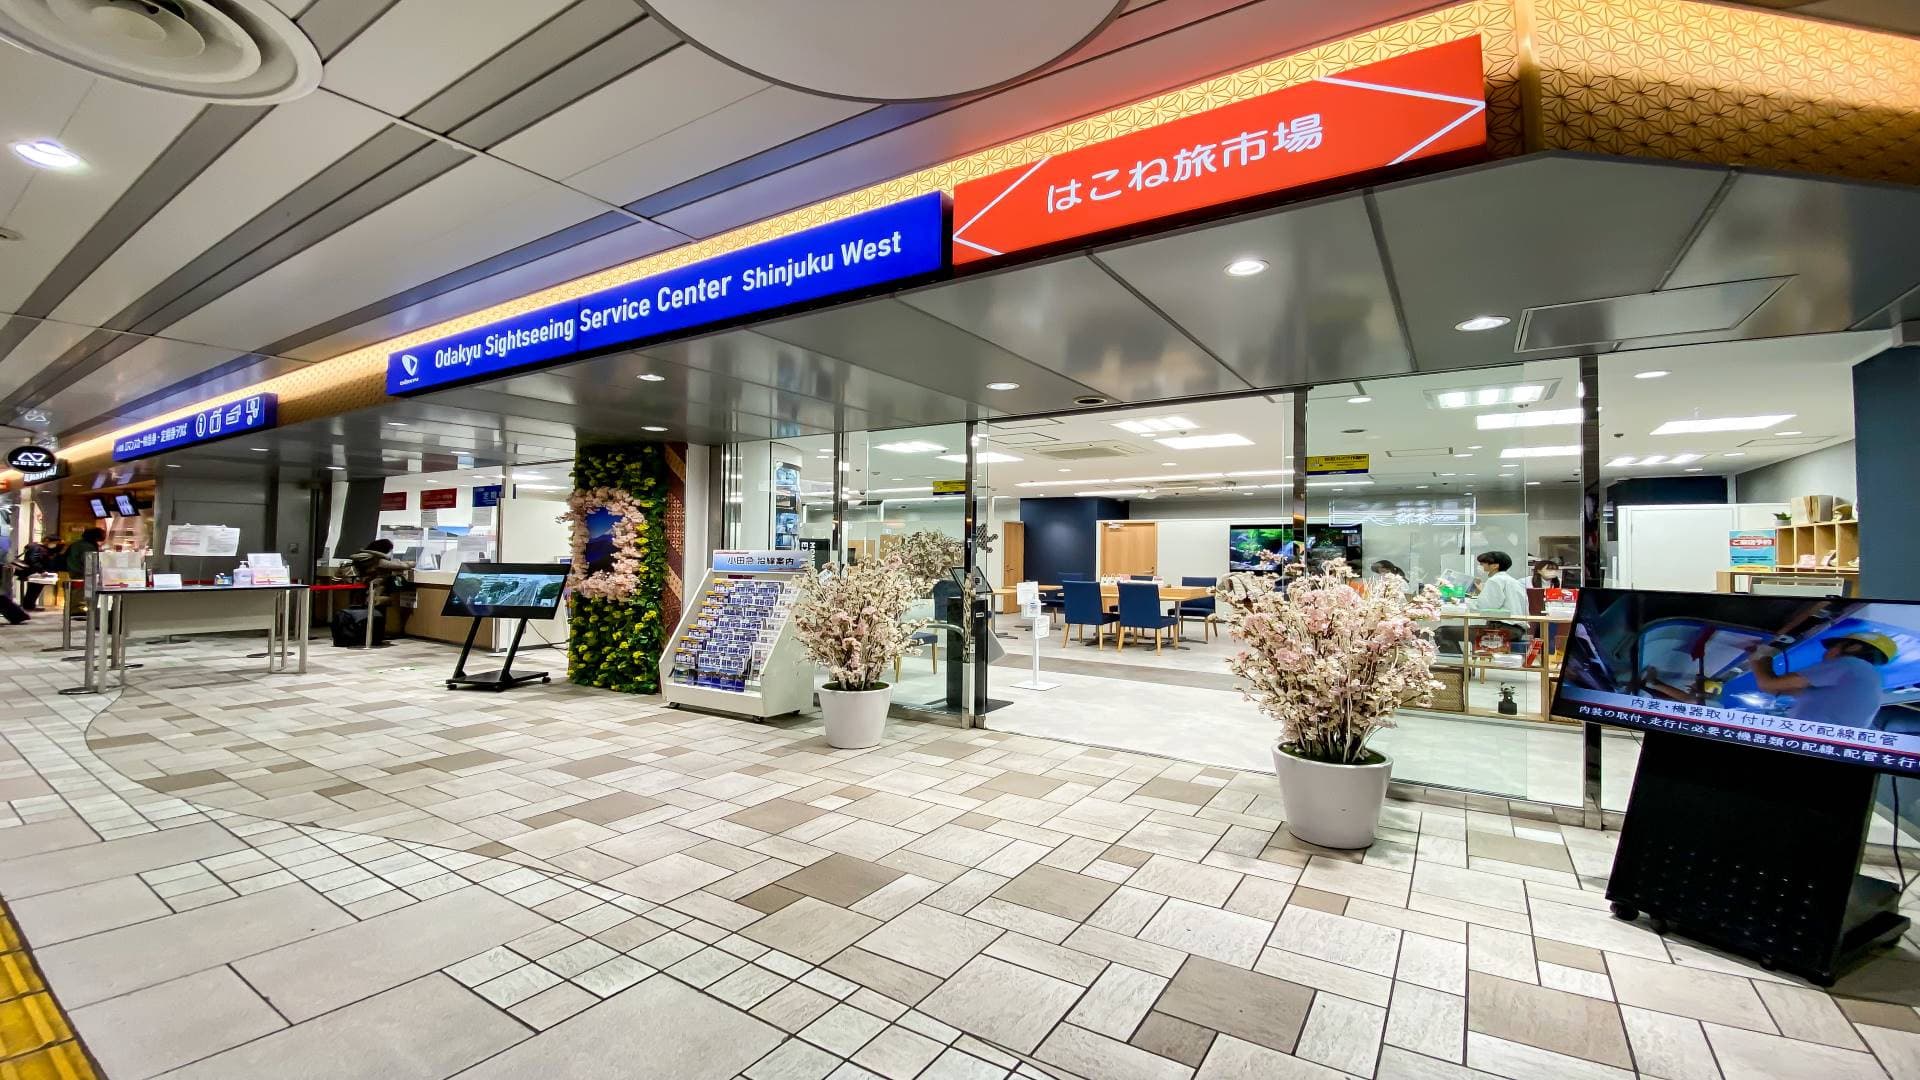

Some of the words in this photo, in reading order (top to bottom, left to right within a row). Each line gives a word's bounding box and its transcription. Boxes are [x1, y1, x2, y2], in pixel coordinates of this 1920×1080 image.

[1047, 114, 1324, 214] はこね旅市場
[435, 343, 482, 369] Odakyu
[485, 318, 574, 356] Sightseeing
[580, 297, 651, 332] Service
[658, 279, 732, 312] Center
[743, 253, 834, 291] Shinjuku
[840, 231, 902, 266] West
[1578, 705, 1920, 769] 内装の取付、走行に必要な機器類の配線、配管を行
[1631, 698, 1899, 747] 内装・機器取り付け及び配線配管
